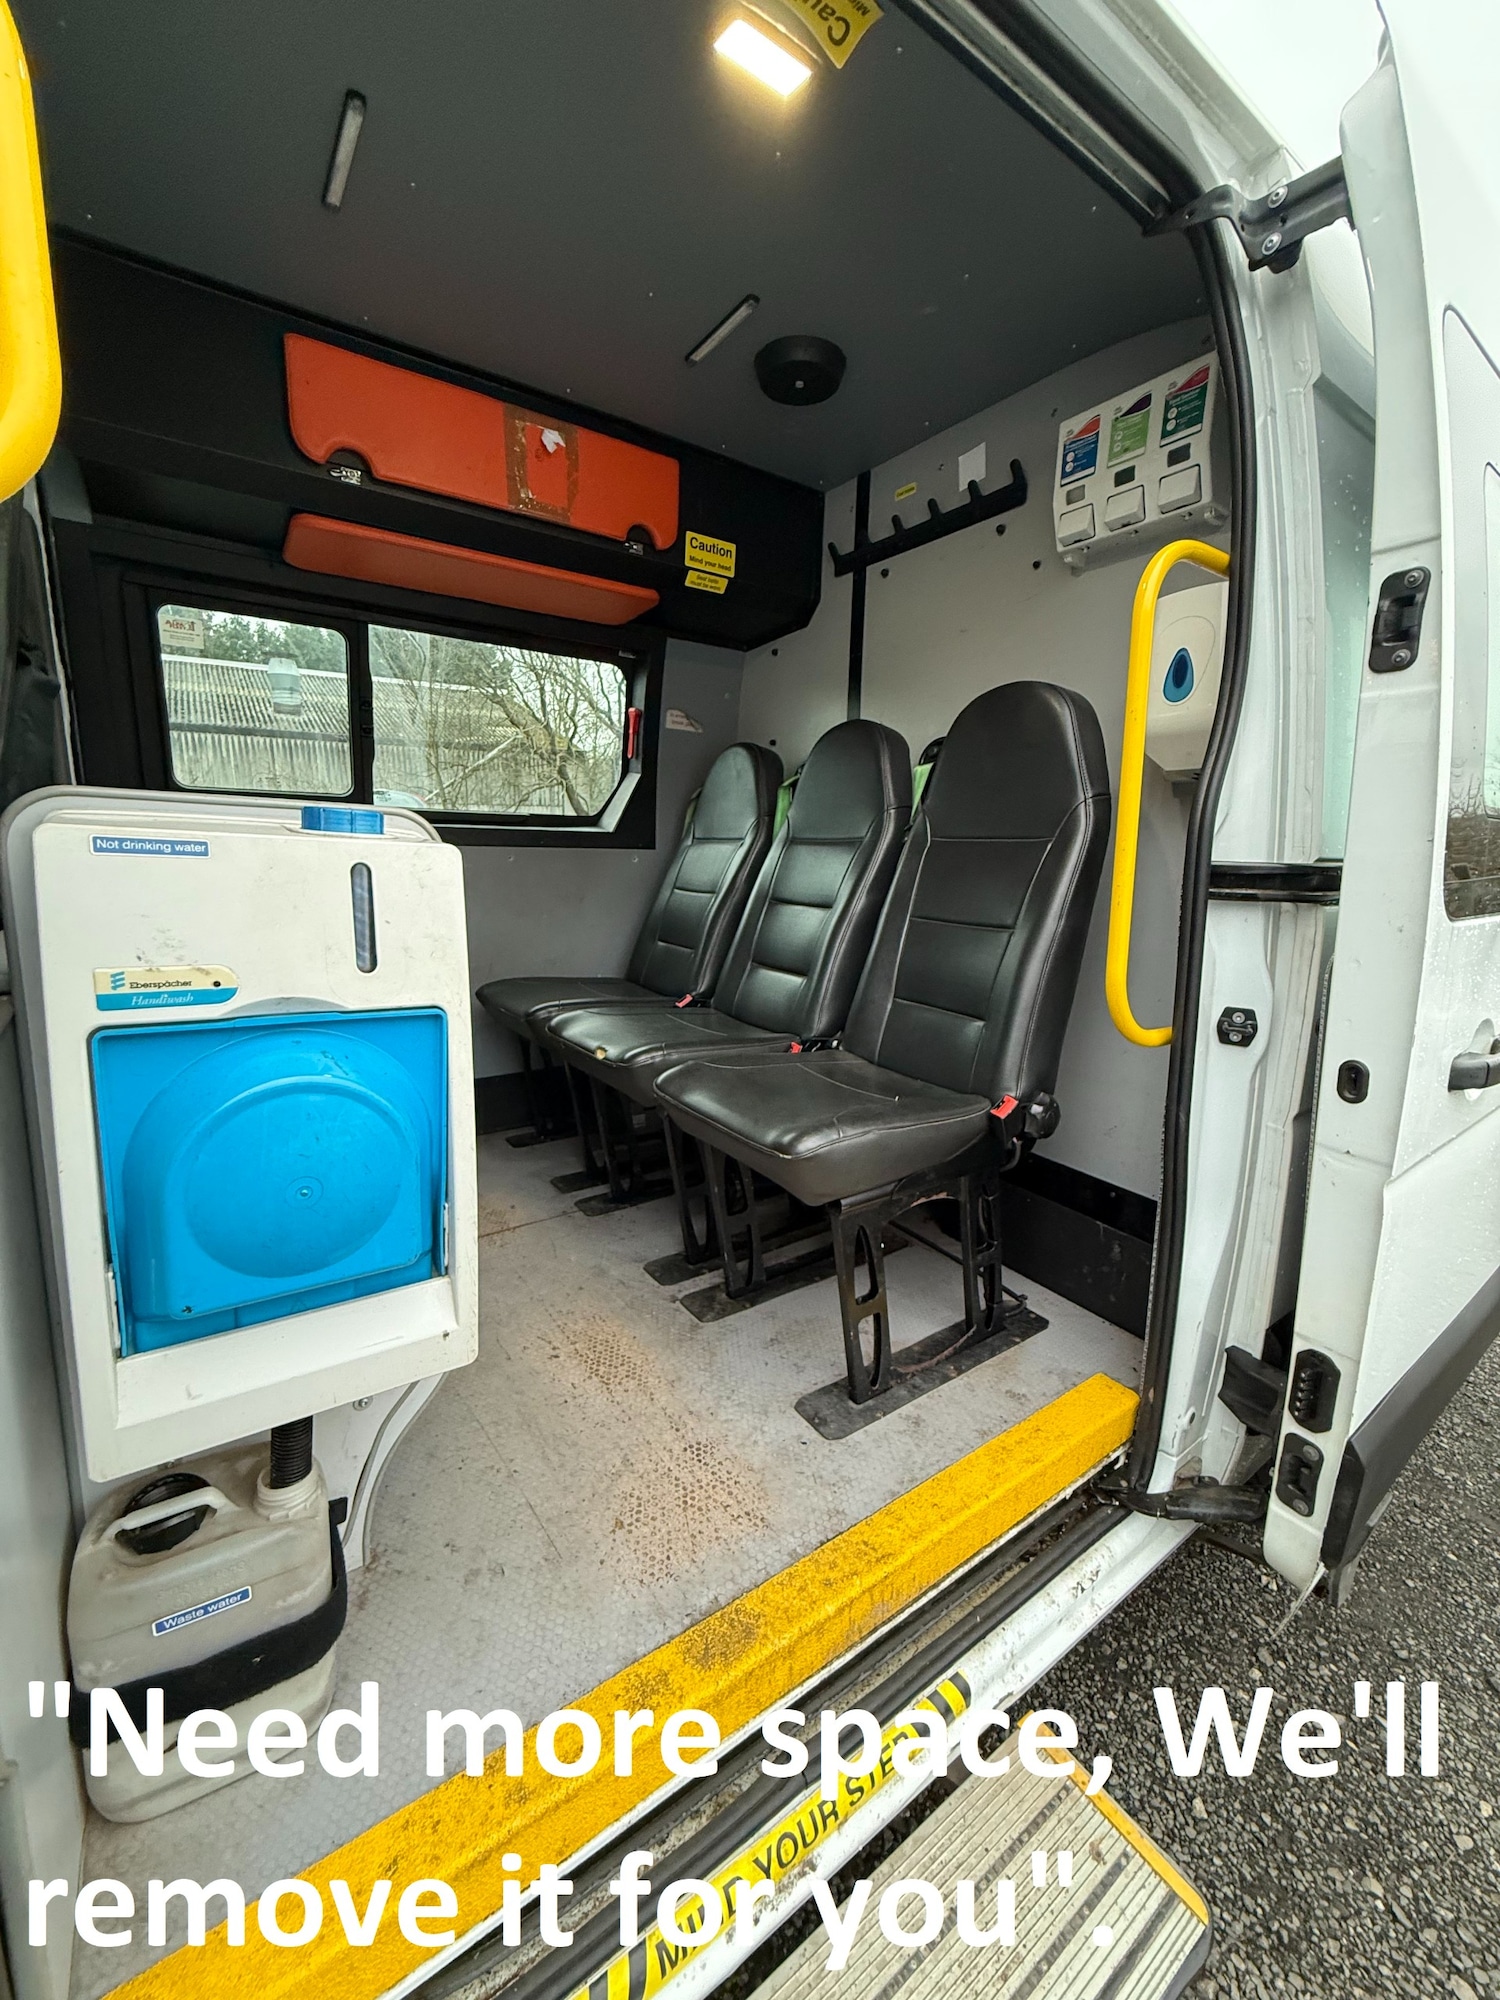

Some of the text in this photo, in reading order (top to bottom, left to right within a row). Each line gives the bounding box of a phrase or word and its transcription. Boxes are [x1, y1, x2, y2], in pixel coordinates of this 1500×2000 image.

[793, 0, 850, 46] Ca
[690, 537, 732, 558] Caution
[690, 555, 703, 564] Mind
[718, 563, 731, 571] head
[96, 838, 206, 853] Not drinking water
[131, 992, 194, 1006] Handiwash
[163, 1593, 242, 1629] Waste water
[752, 1800, 840, 1881] YOUR
